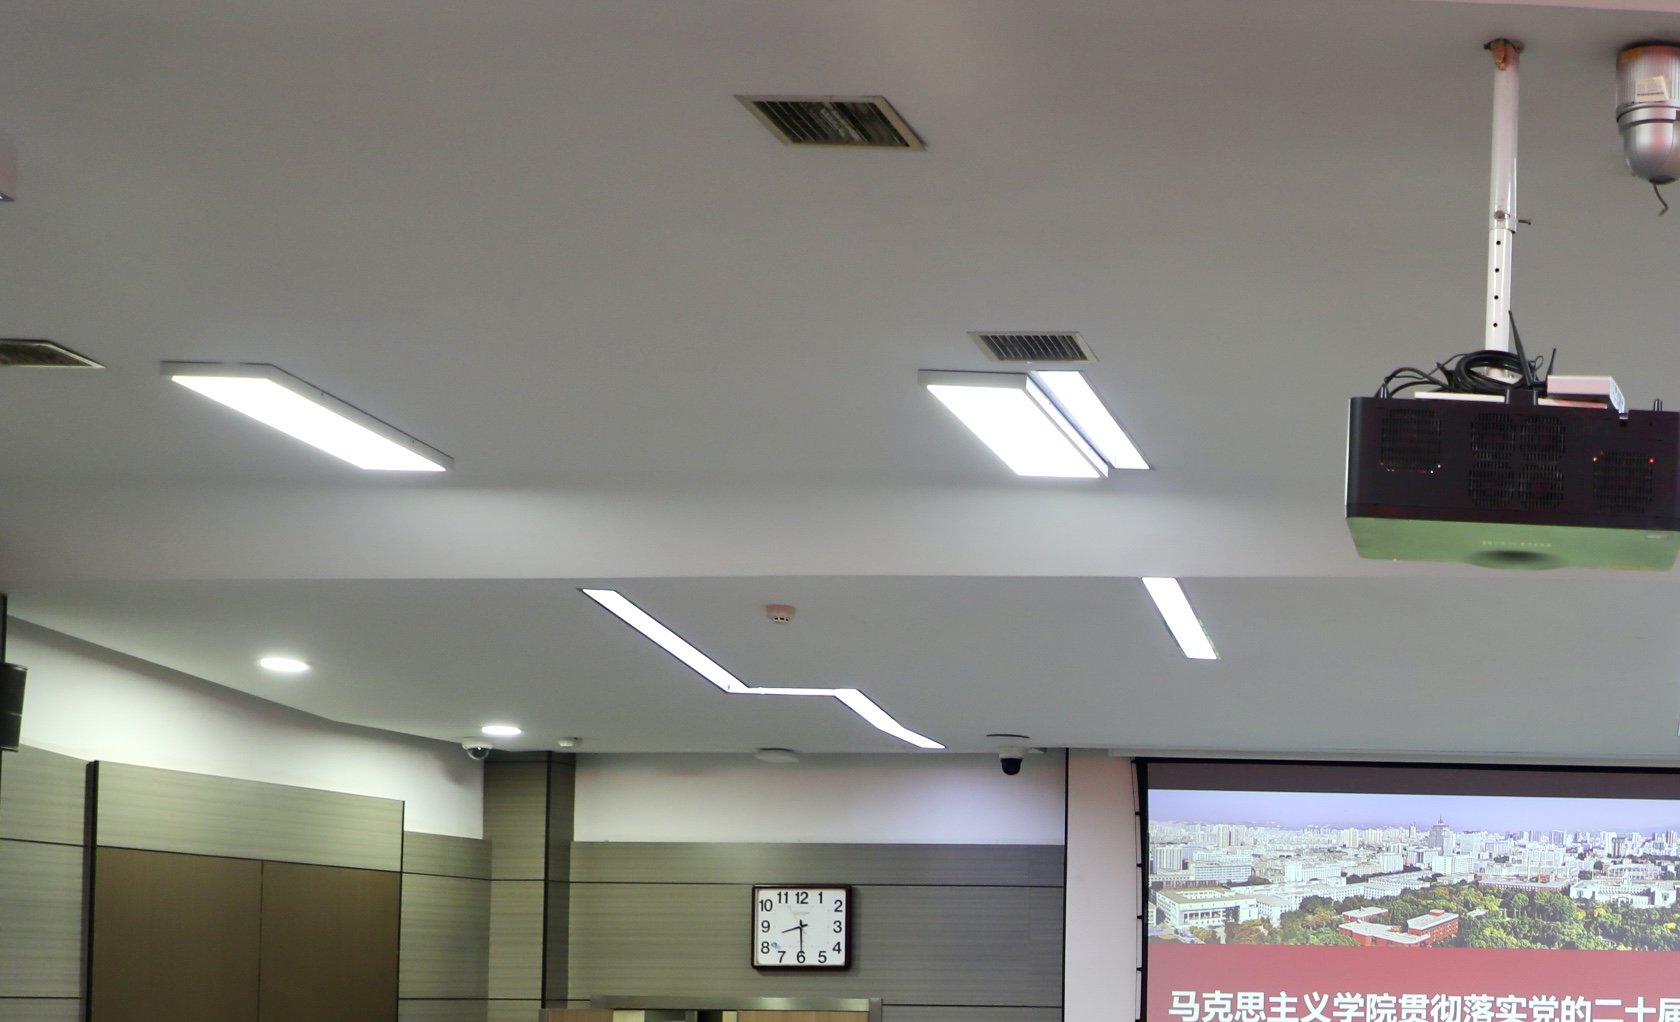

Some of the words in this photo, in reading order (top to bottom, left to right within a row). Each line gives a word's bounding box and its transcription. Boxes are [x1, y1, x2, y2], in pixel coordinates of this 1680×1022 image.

[777, 892, 788, 904] 11
[796, 892, 808, 904] 12
[818, 892, 822, 904] 1
[760, 899, 772, 912] 10
[834, 900, 842, 912] 2
[761, 920, 770, 932] 9
[833, 921, 842, 933] 3
[761, 941, 770, 954] 8
[832, 942, 842, 954] 4
[778, 951, 786, 963] 7
[797, 951, 806, 963] 6
[818, 951, 827, 963] 5
